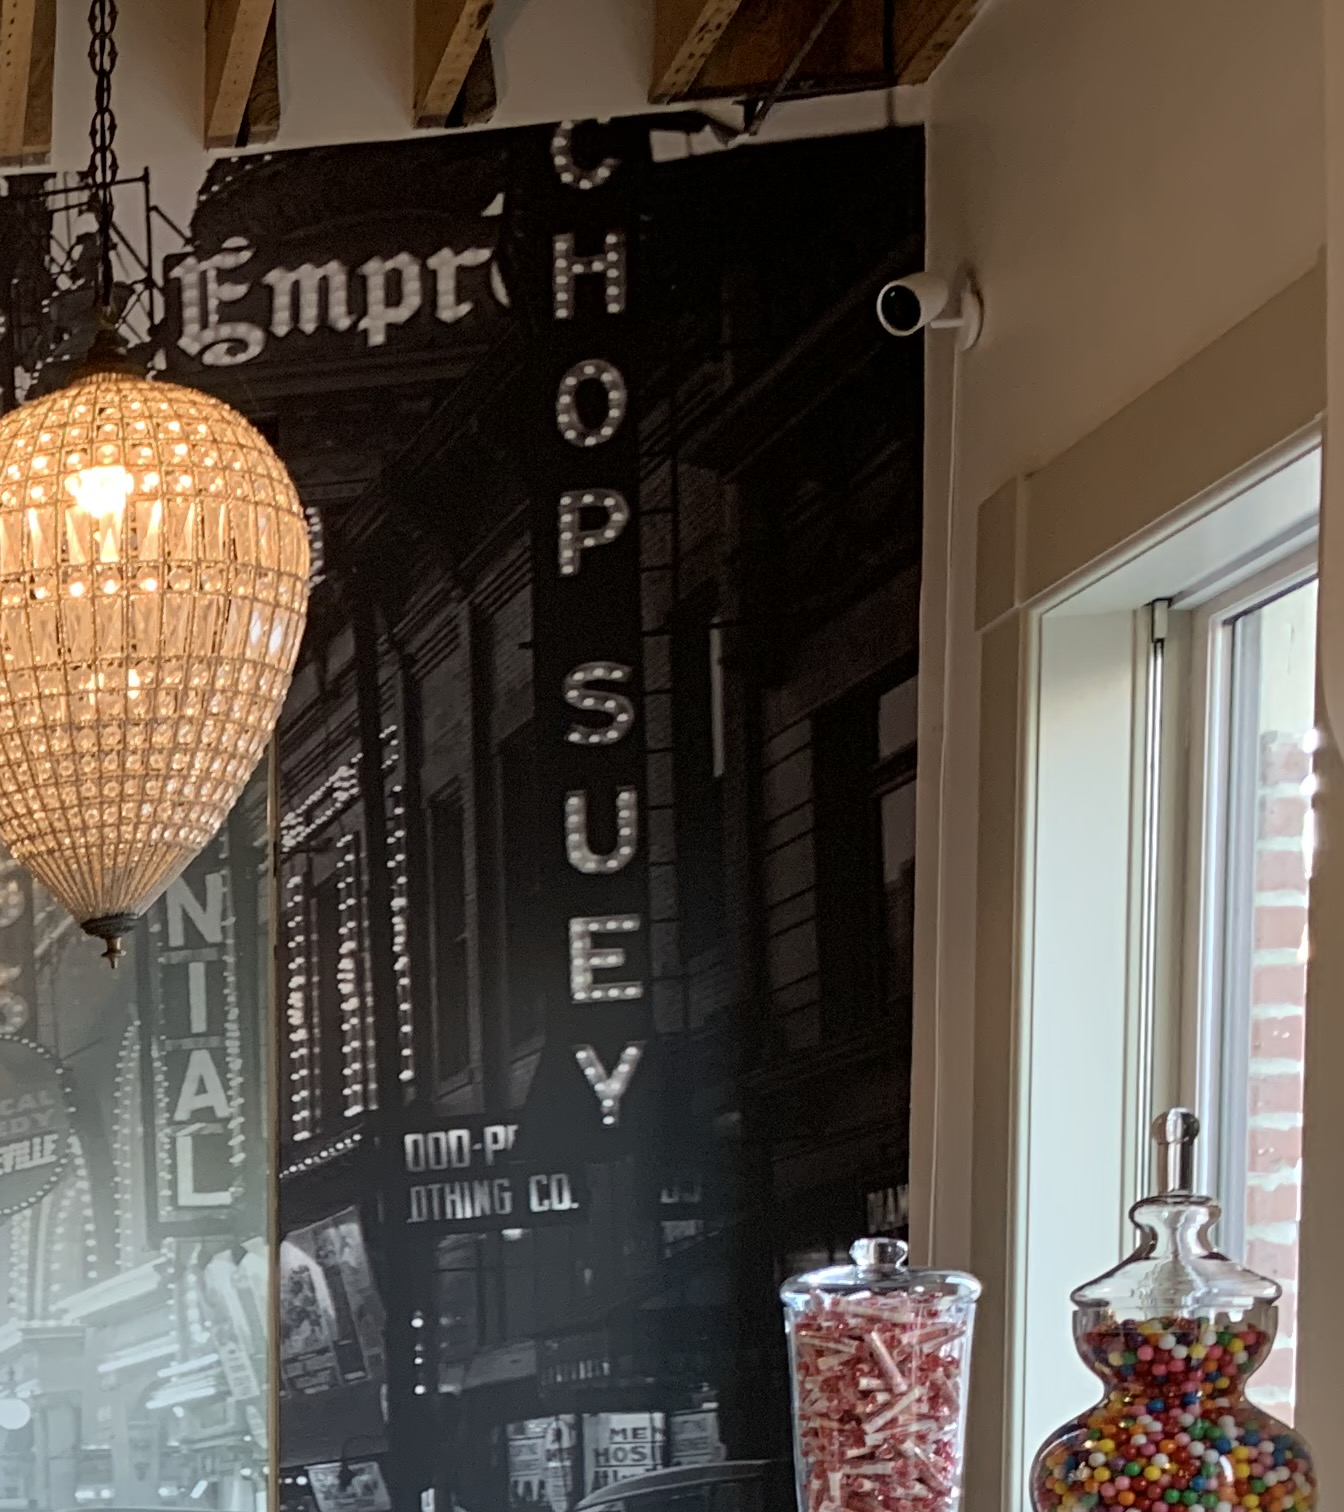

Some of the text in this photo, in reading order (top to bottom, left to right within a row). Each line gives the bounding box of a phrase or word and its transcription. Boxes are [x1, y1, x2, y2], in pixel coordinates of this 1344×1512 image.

[168, 236, 510, 366] Empr
[551, 120, 646, 1128] CHOP SUEY
[406, 1173, 580, 1224] OTHING CO.
